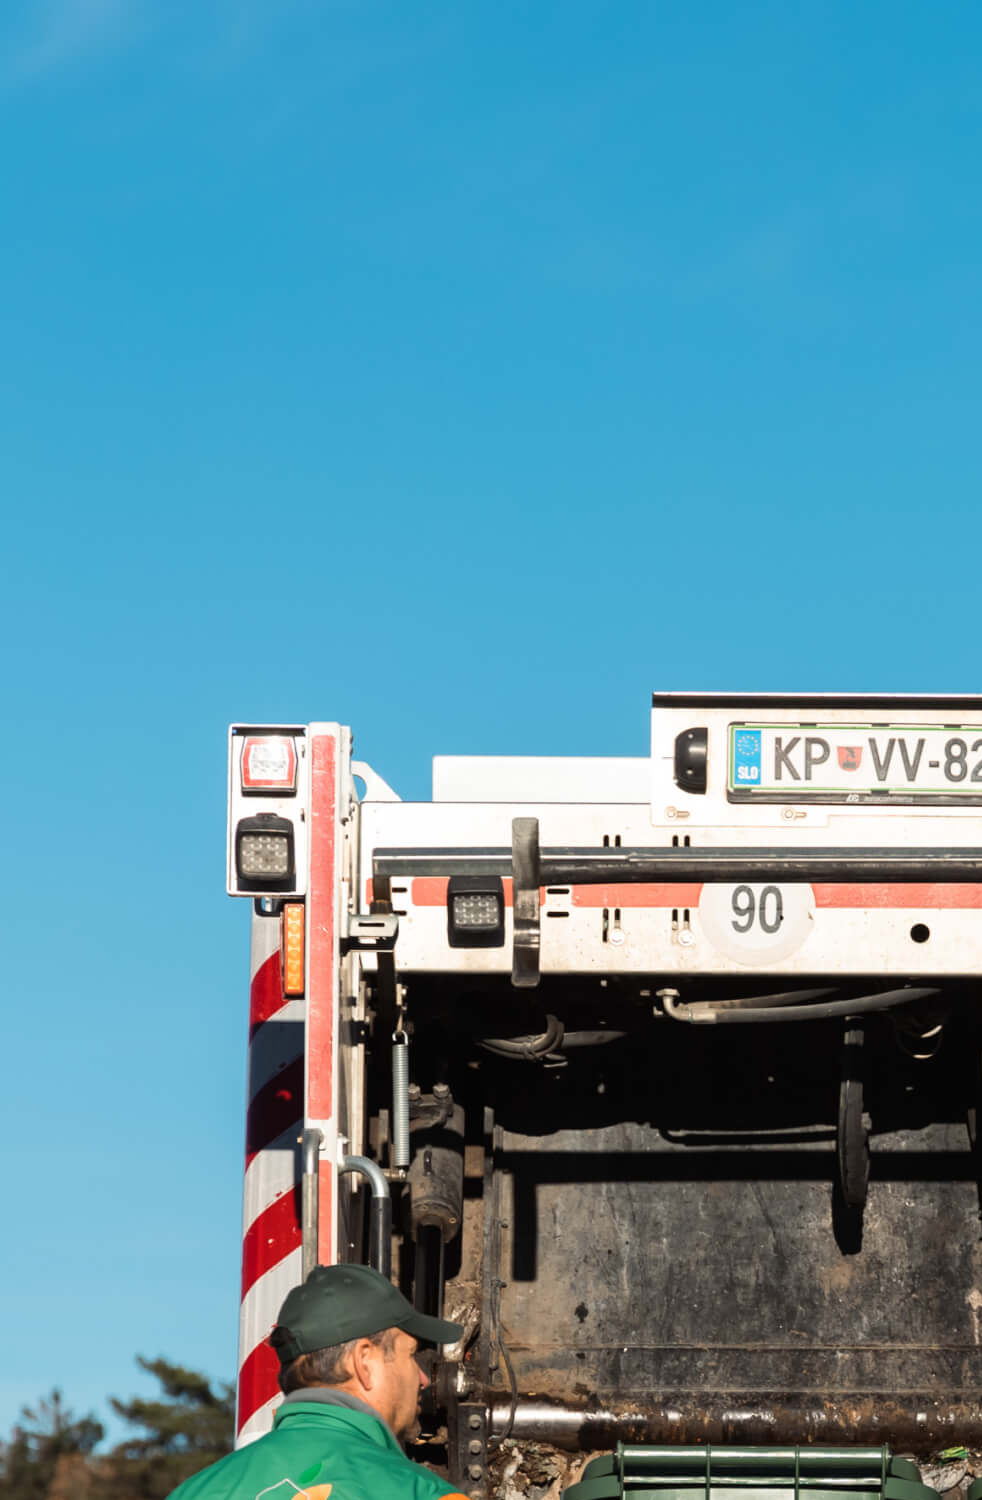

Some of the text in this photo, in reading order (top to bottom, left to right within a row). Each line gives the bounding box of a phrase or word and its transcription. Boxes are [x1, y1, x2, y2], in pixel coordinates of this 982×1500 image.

[737, 765, 760, 781] SLO
[774, 736, 831, 781] KP
[731, 884, 784, 934] 90
